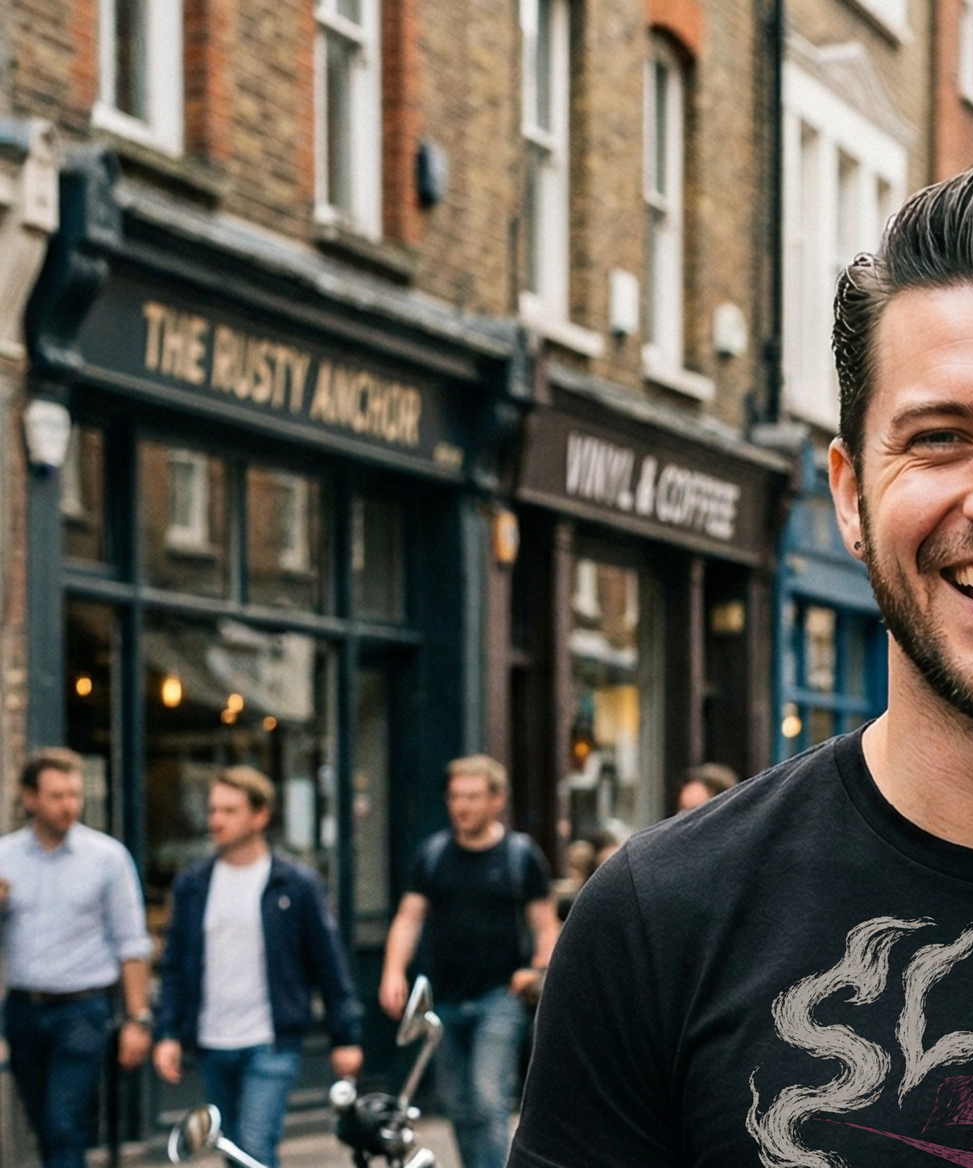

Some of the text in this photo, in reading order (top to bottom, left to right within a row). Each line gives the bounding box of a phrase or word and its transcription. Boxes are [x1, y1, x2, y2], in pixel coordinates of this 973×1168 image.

[144, 302, 422, 446] THE RUSTY ANCHOR
[566, 431, 740, 540] VINYL & COFFEE
